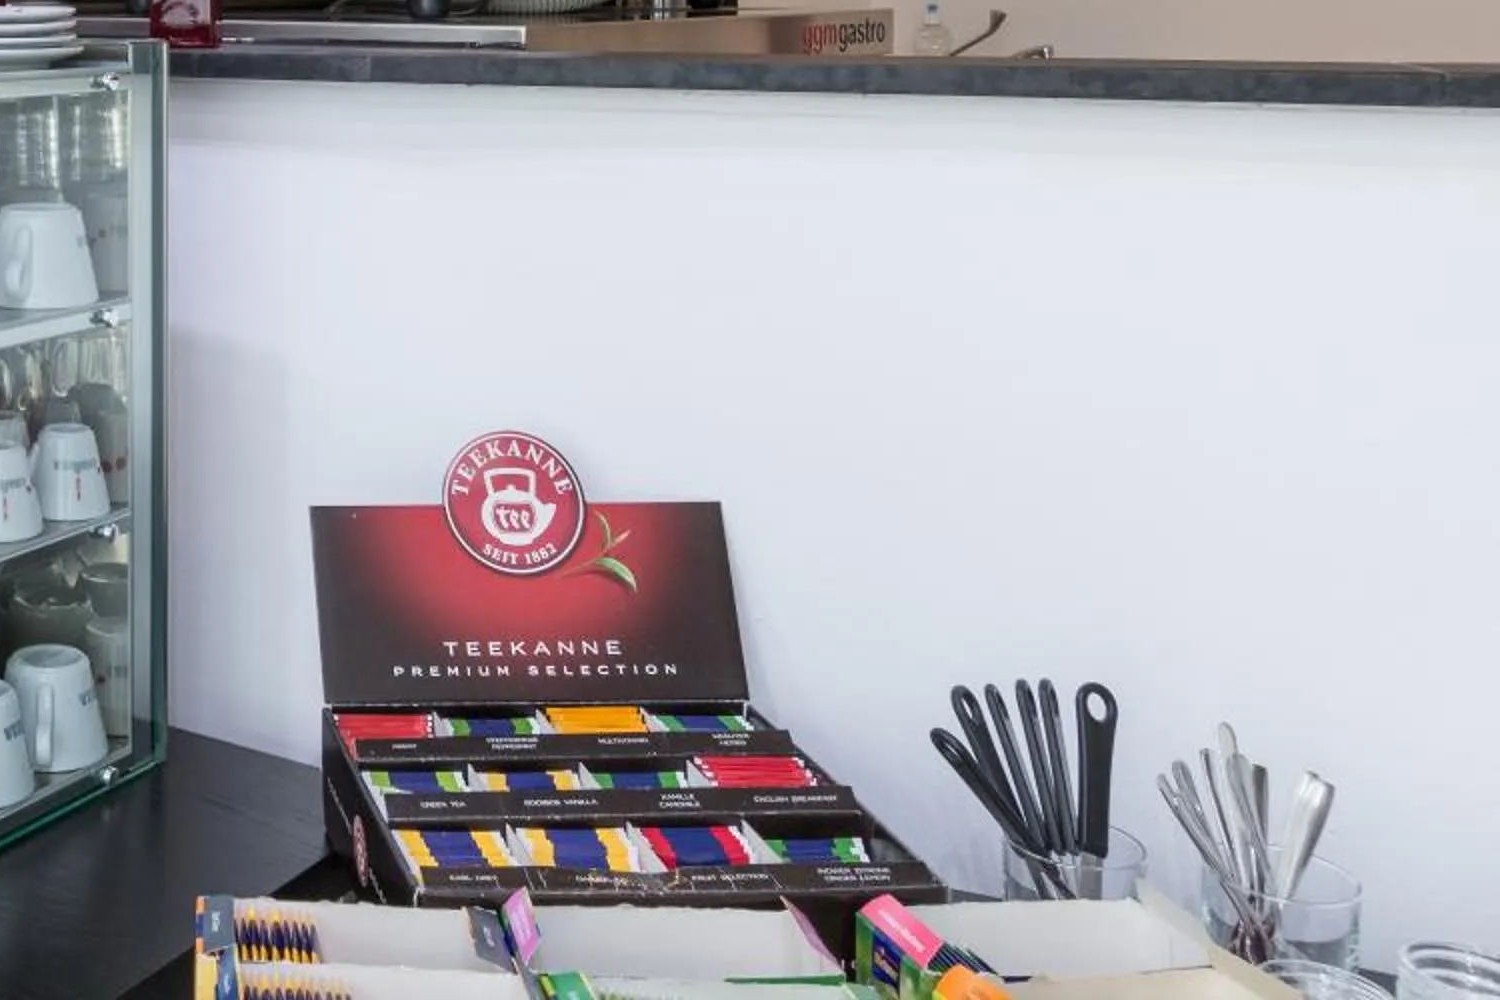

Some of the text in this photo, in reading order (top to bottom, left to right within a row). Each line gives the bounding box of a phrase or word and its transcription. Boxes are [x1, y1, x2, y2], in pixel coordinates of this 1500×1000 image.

[452, 439, 573, 496] TEEKANNE
[482, 543, 518, 565] SEIT
[443, 640, 623, 657] TEEKANNE
[393, 663, 678, 677] PREMIUM SELECTION
